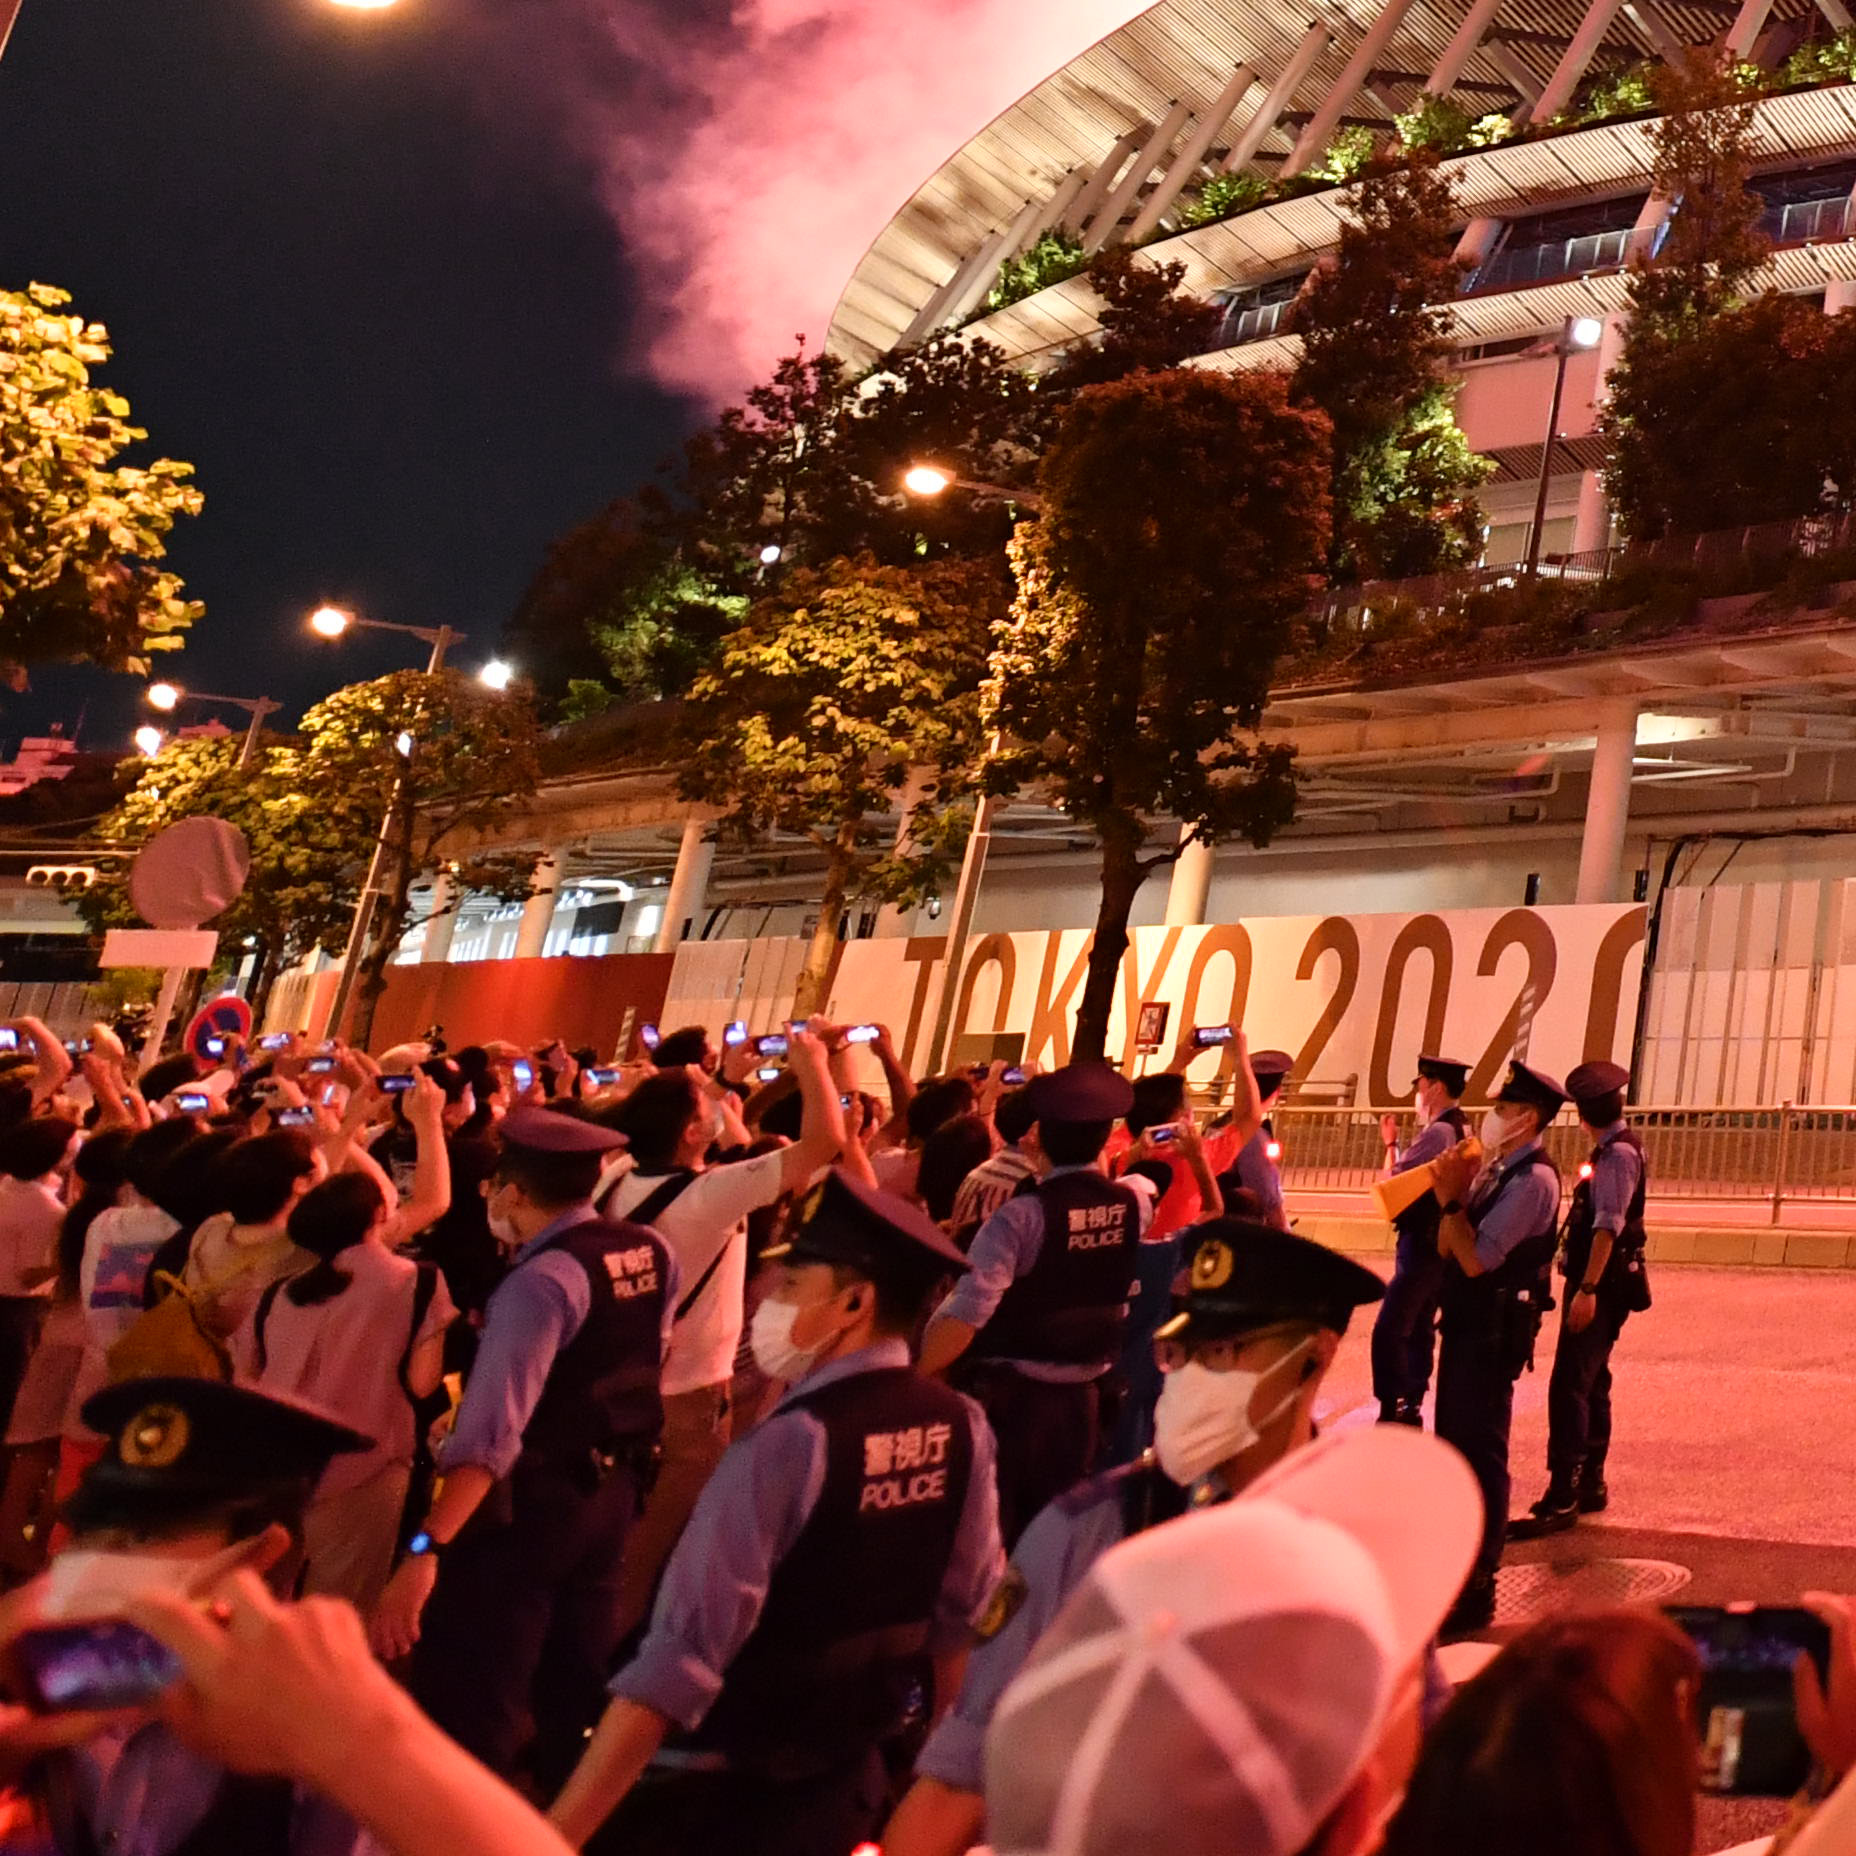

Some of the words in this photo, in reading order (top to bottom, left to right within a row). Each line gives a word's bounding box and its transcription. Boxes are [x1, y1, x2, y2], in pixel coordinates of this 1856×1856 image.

[903, 923, 1253, 1106] TOKYO
[1068, 1228, 1124, 1250] POLICE
[859, 1469, 946, 1512] POLICE
